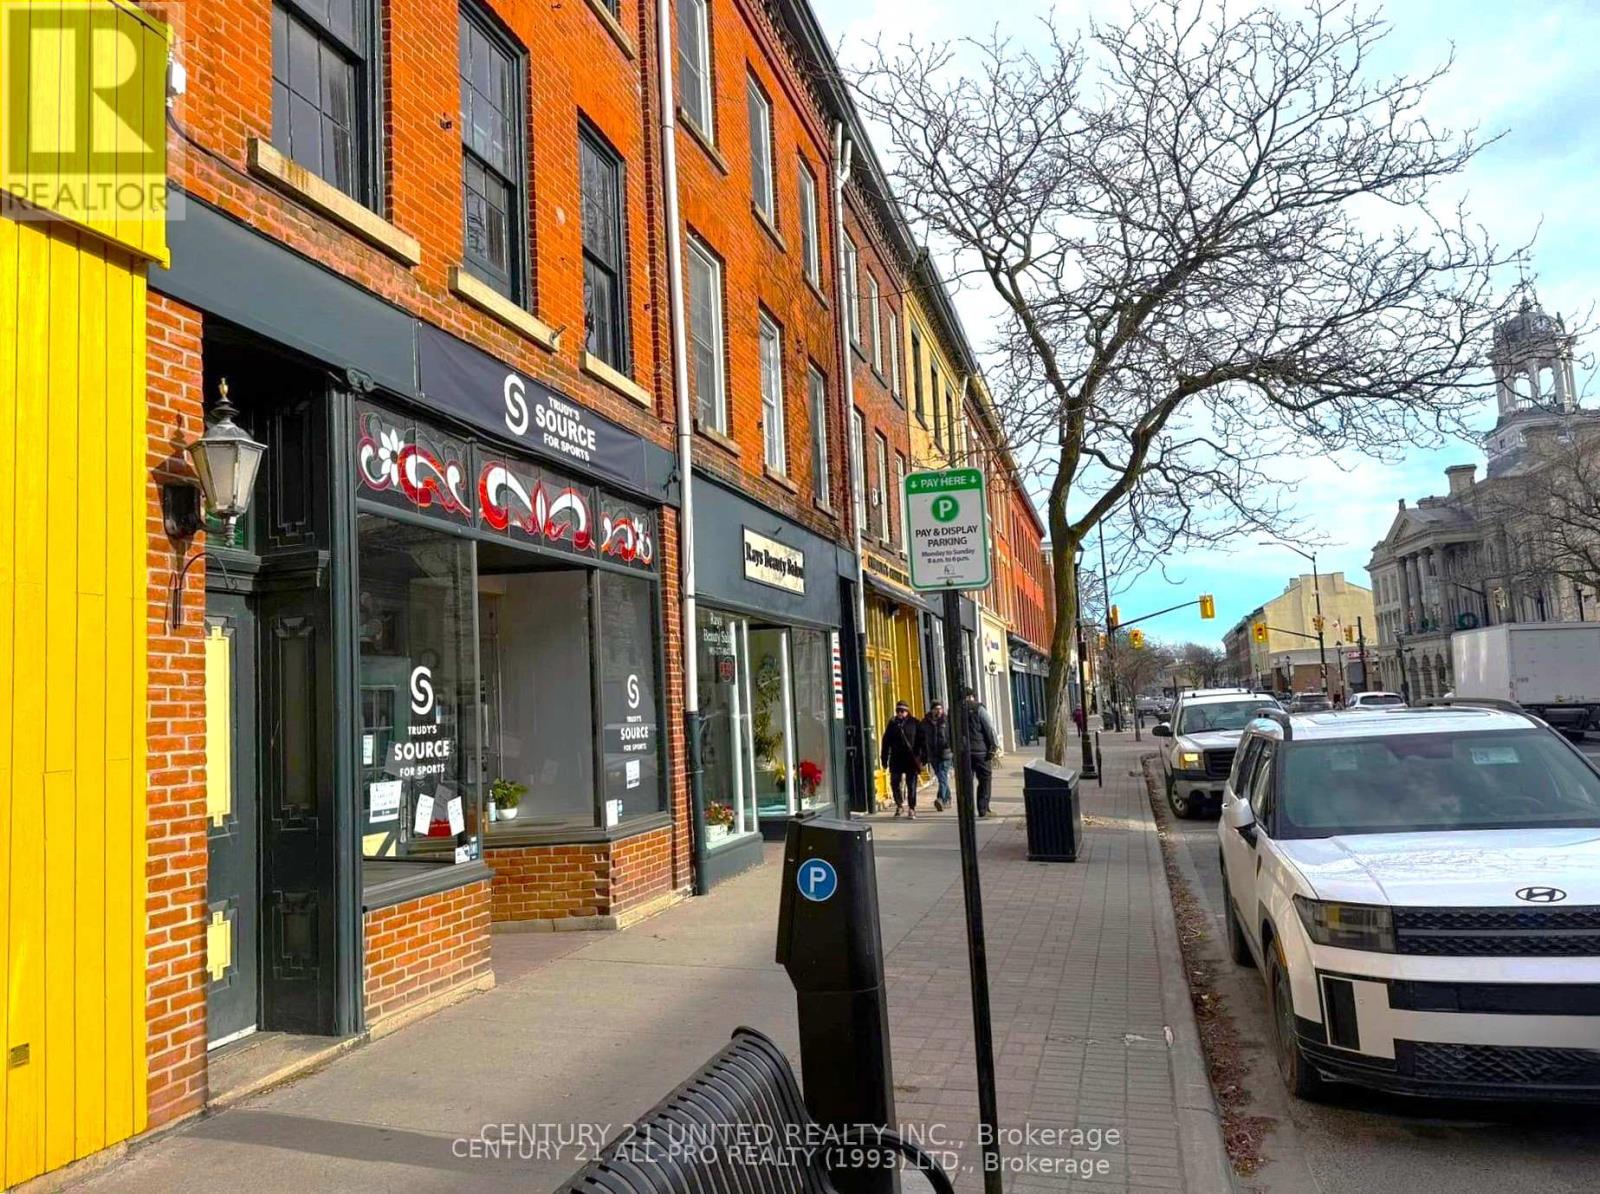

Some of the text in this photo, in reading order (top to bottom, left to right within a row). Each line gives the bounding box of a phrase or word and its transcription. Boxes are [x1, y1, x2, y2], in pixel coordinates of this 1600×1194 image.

[547, 396, 580, 421] TRUDY'S
[535, 404, 596, 451] SOURCE
[543, 432, 590, 461] FOR SPORTS
[920, 475, 967, 489] PAY HERE
[939, 500, 953, 518] P
[915, 525, 978, 538] PAY & DISPLAY
[927, 536, 968, 548] PARKING
[921, 550, 945, 558] Monday
[953, 548, 975, 557] Sunday
[763, 549, 787, 577] Beauty
[407, 725, 437, 735] TRUDY'S
[620, 725, 649, 741] SOURCE
[394, 740, 450, 761] SOURCE
[632, 742, 647, 751] SPORTS
[400, 763, 445, 777] FOR SPORTS
[809, 866, 827, 893] P
